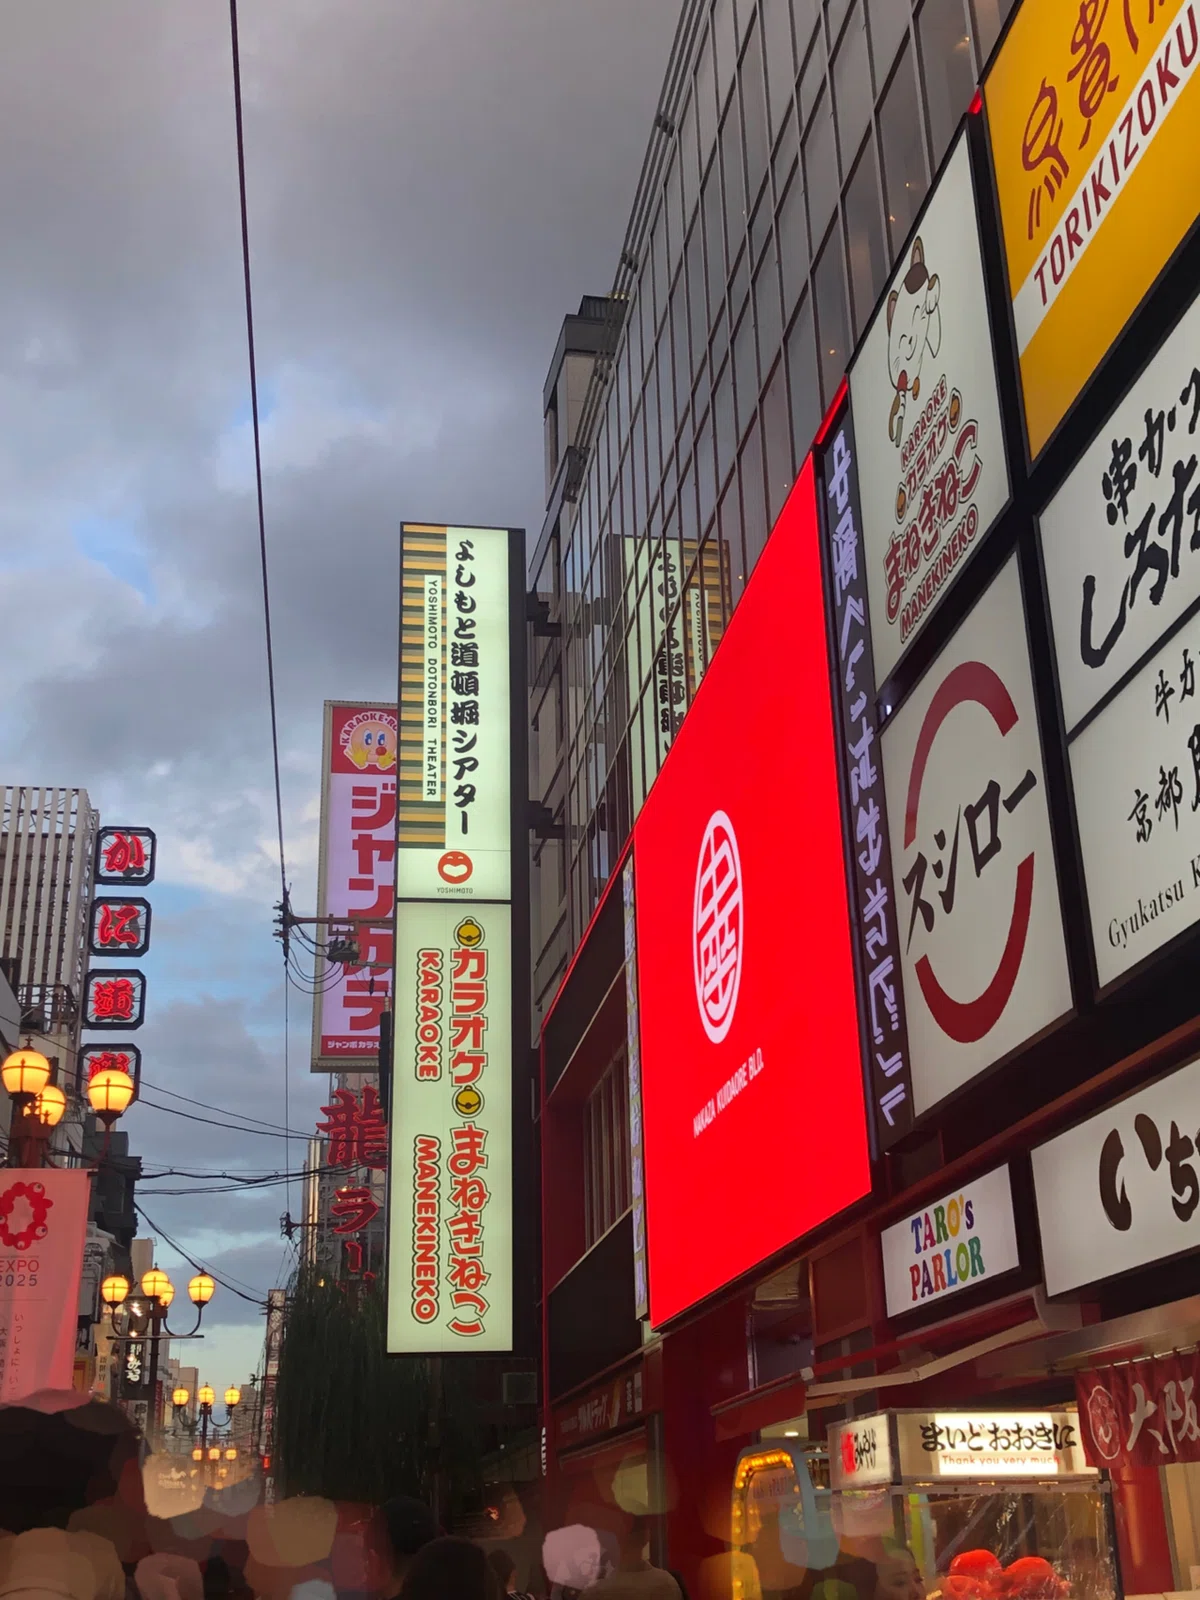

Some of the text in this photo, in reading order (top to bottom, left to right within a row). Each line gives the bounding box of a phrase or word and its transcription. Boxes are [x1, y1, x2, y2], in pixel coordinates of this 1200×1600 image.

[1034, 4, 1199, 306] TORIKIZOKU
[900, 374, 948, 474] KARAOKE
[905, 404, 950, 501] カラオケ
[884, 419, 983, 626] まねきねこ
[900, 503, 979, 645] MANEKINEKO
[426, 579, 438, 797] YOSHIMOTO DOTONBORI THEATER
[450, 539, 480, 836] よしもと道頓堀シアター
[1155, 648, 1200, 725] 牛カ
[436, 886, 474, 895] YOSHIMOTO
[902, 769, 1037, 955] スシロー
[1108, 878, 1184, 949] Gyukatsu
[411, 948, 443, 1324] KARAOKE MANEKINEKO
[446, 948, 492, 1338] カラオケ まねきねこ
[1099, 1113, 1200, 1231] いち
[909, 1236, 985, 1301] PARLOR
[919, 1421, 1078, 1452] まいどおおきに
[942, 1454, 1061, 1467] Thank you very much
[1127, 1376, 1200, 1455] 大阪
